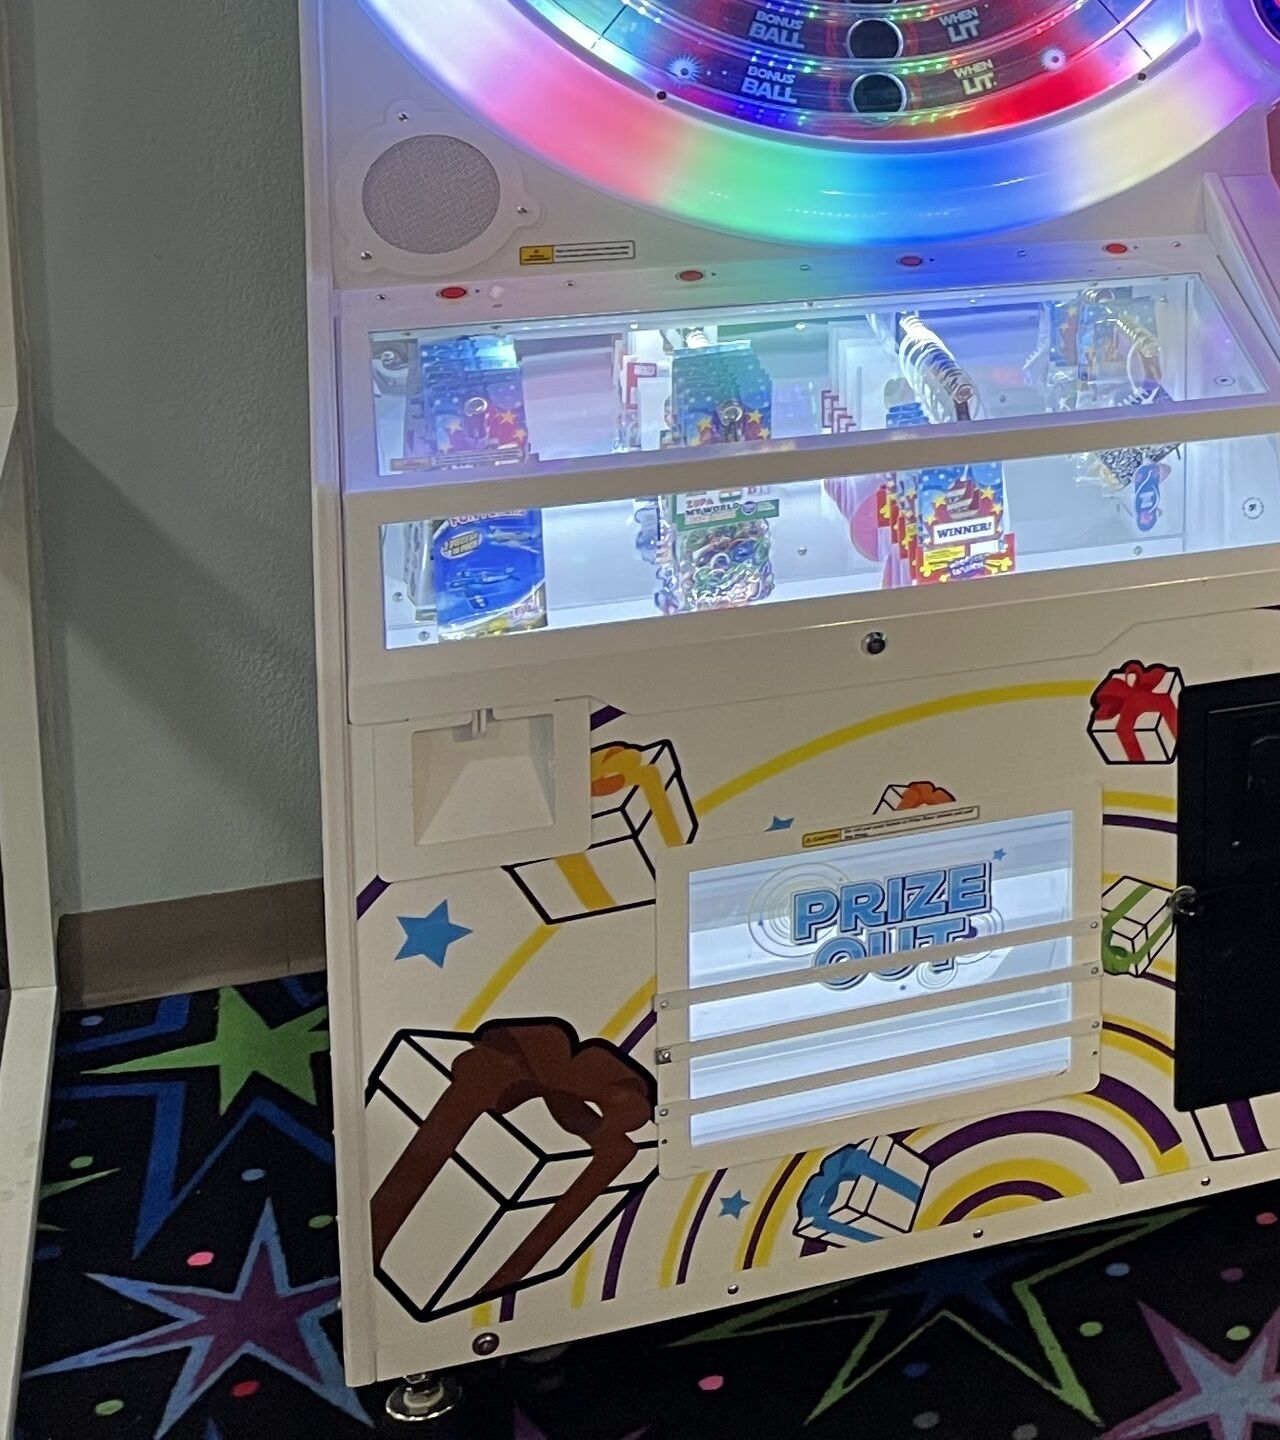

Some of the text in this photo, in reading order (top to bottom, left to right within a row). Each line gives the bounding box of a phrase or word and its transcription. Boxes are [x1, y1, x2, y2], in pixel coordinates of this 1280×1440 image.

[755, 10, 804, 31] BONUS
[938, 7, 979, 28] WHEN
[748, 19, 806, 50] BALL
[947, 18, 980, 43] LIT
[747, 64, 796, 86] BONUS
[952, 58, 994, 80] WHEN
[741, 75, 798, 103] BALL
[936, 521, 993, 539] WINNER!
[790, 862, 993, 947] PRIZE
[812, 917, 972, 991] OUT
